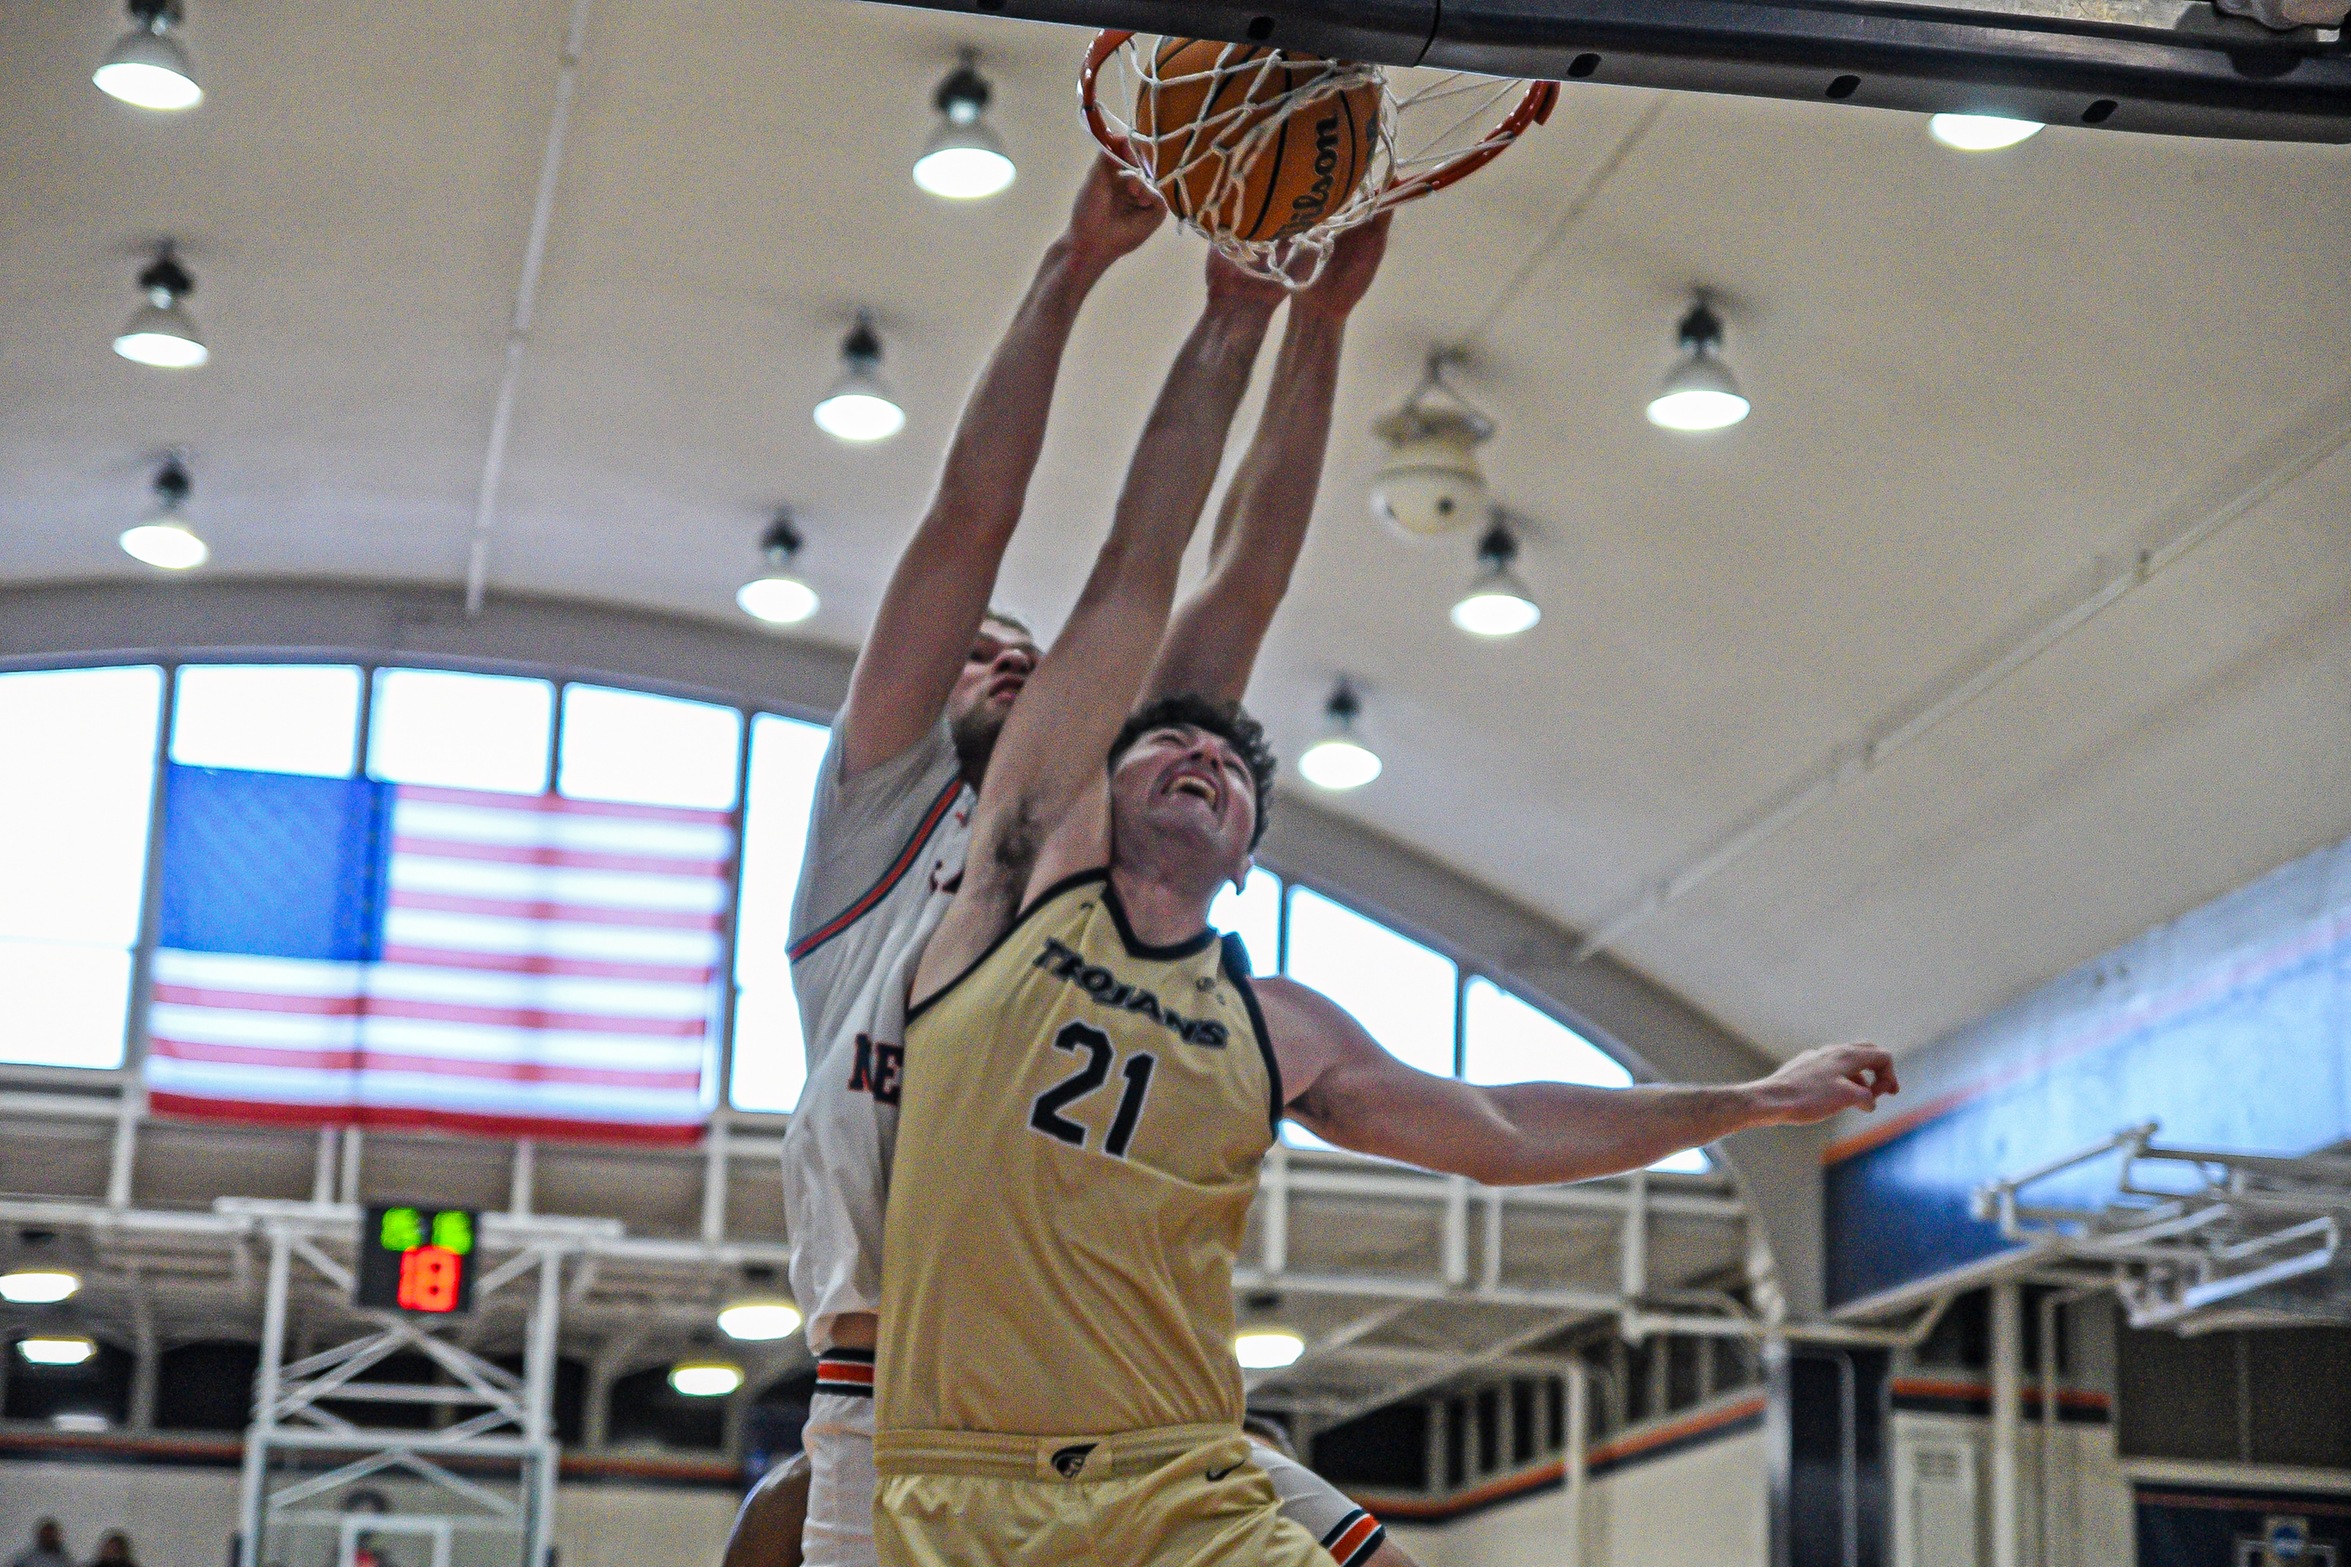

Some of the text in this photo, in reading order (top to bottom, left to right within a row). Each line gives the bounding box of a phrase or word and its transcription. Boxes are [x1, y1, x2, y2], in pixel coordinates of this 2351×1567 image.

[1032, 934, 1230, 1050] TROJANS
[1029, 1019, 1156, 1161] 21
[397, 1244, 462, 1312] 18
